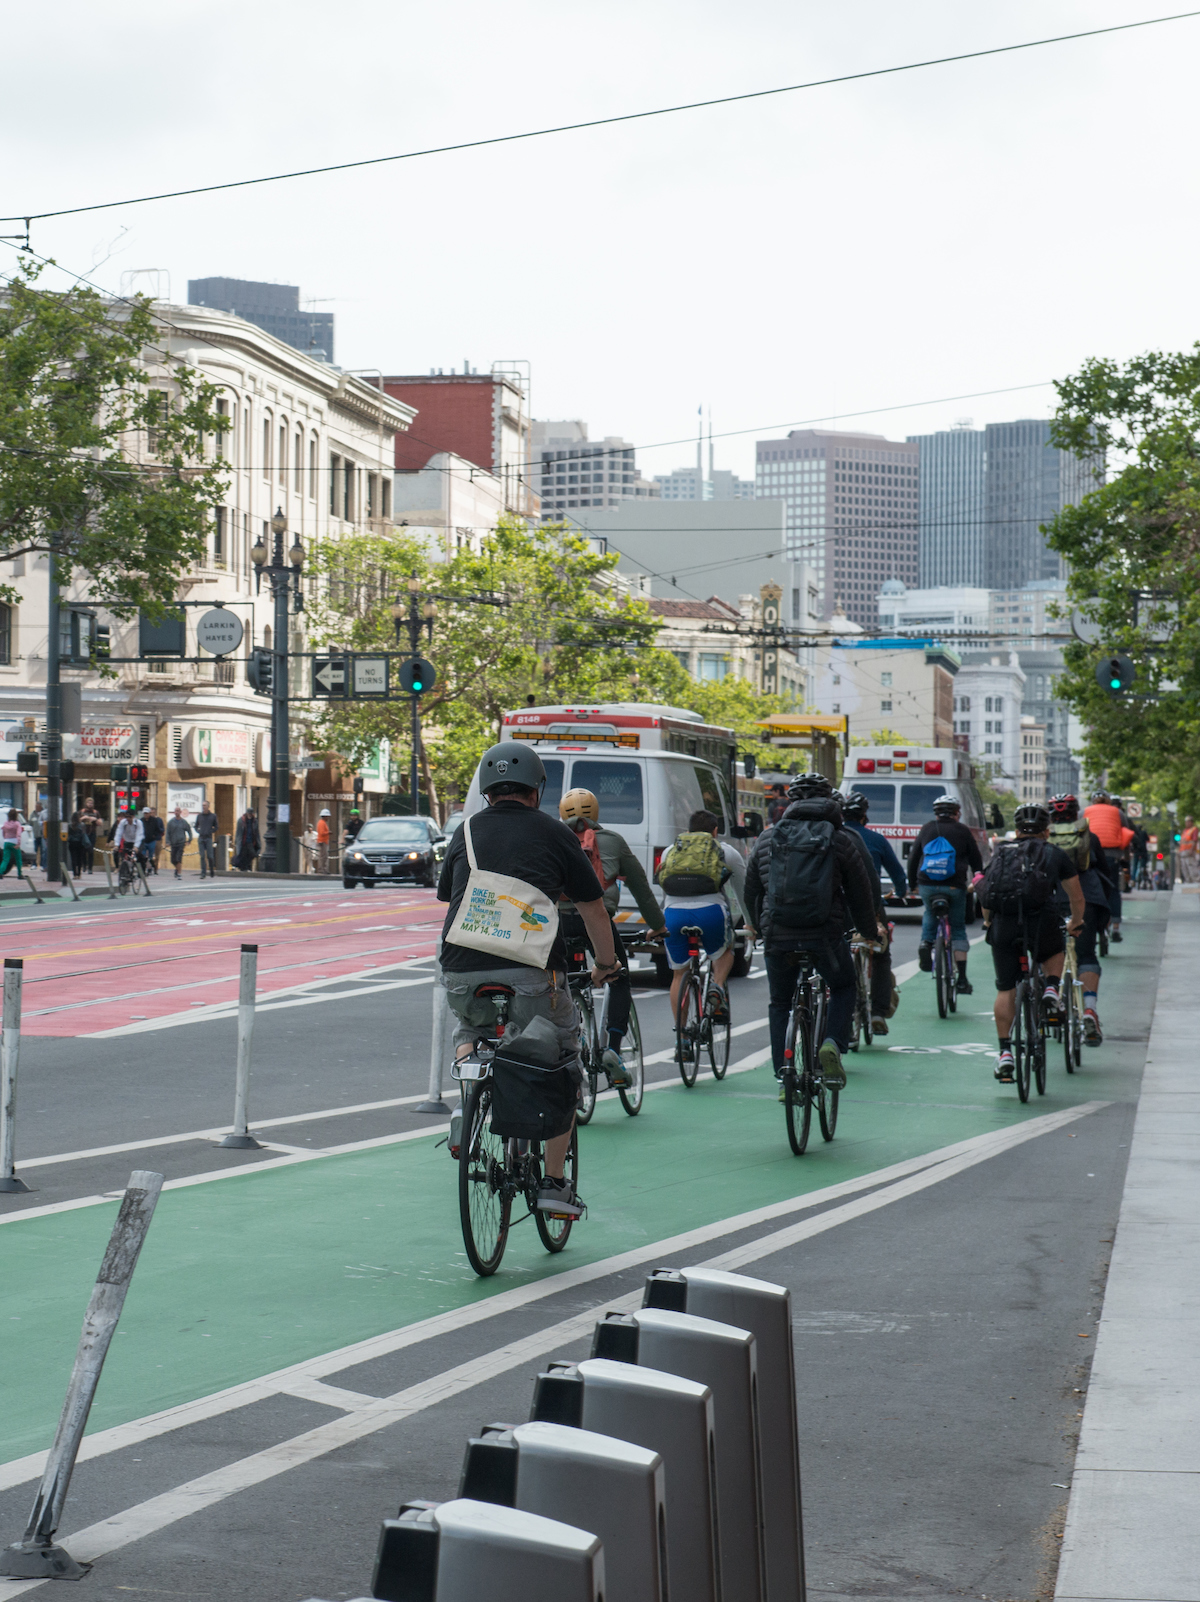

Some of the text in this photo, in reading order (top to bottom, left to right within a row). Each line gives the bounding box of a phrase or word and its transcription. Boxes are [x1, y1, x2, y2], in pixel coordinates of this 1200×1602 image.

[205, 634, 233, 642] HAYES
[364, 668, 376, 676] NO
[358, 676, 383, 685] TURNS
[517, 715, 540, 724] 8148
[98, 727, 132, 737] center
[80, 737, 120, 746] MARKET
[93, 748, 132, 759] LIQUORS
[472, 888, 496, 899] BIKE TO
[470, 897, 486, 905] WORK
[485, 898, 498, 906] DAY
[460, 922, 511, 940] MAY 14, 2015
